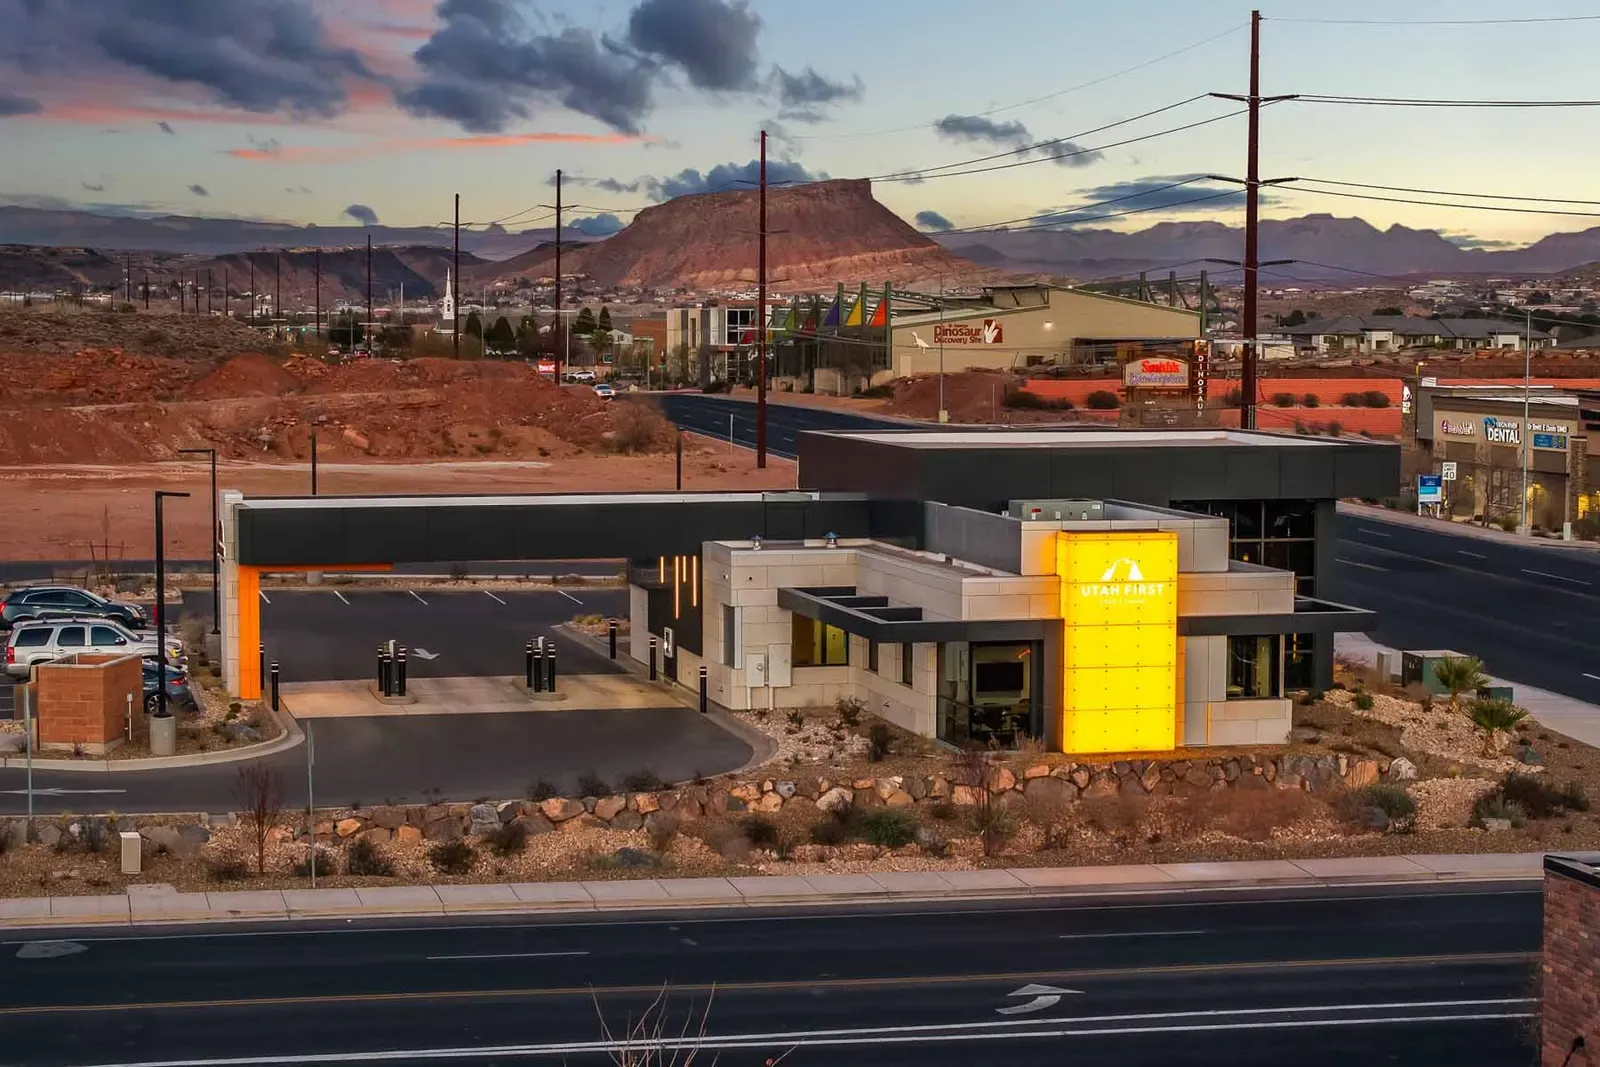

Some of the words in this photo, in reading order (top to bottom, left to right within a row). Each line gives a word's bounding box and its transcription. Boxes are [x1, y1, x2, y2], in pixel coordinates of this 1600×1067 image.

[934, 325, 982, 336] Dinosaur
[934, 336, 967, 344] Discovery
[969, 336, 982, 344] Site
[1488, 427, 1520, 443] DENTAL
[1444, 471, 1454, 479] 40
[1081, 584, 1120, 597] UTAH
[1124, 583, 1164, 596] FIRST
